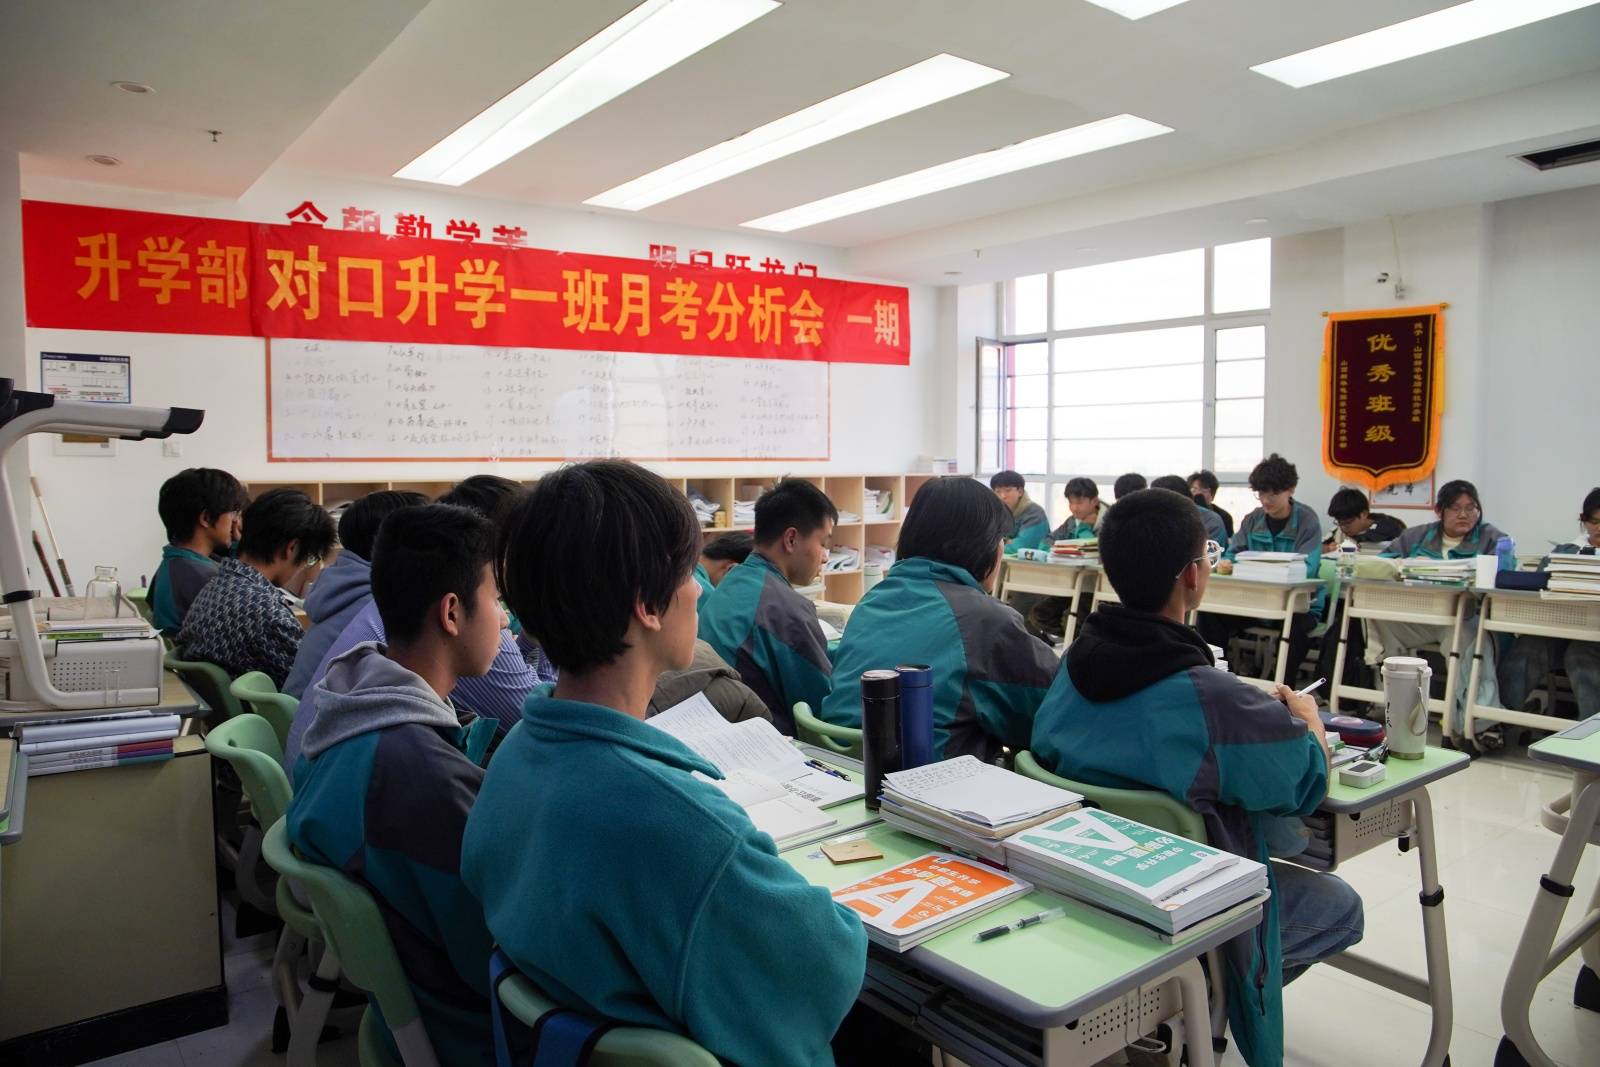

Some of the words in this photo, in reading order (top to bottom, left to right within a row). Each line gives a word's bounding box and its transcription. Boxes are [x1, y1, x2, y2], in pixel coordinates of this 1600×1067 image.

[74, 232, 249, 309] 升学部
[265, 244, 825, 348] 对口升学一班月考分析会
[846, 299, 900, 346] 一期
[1364, 334, 1398, 442] 优秀班级
